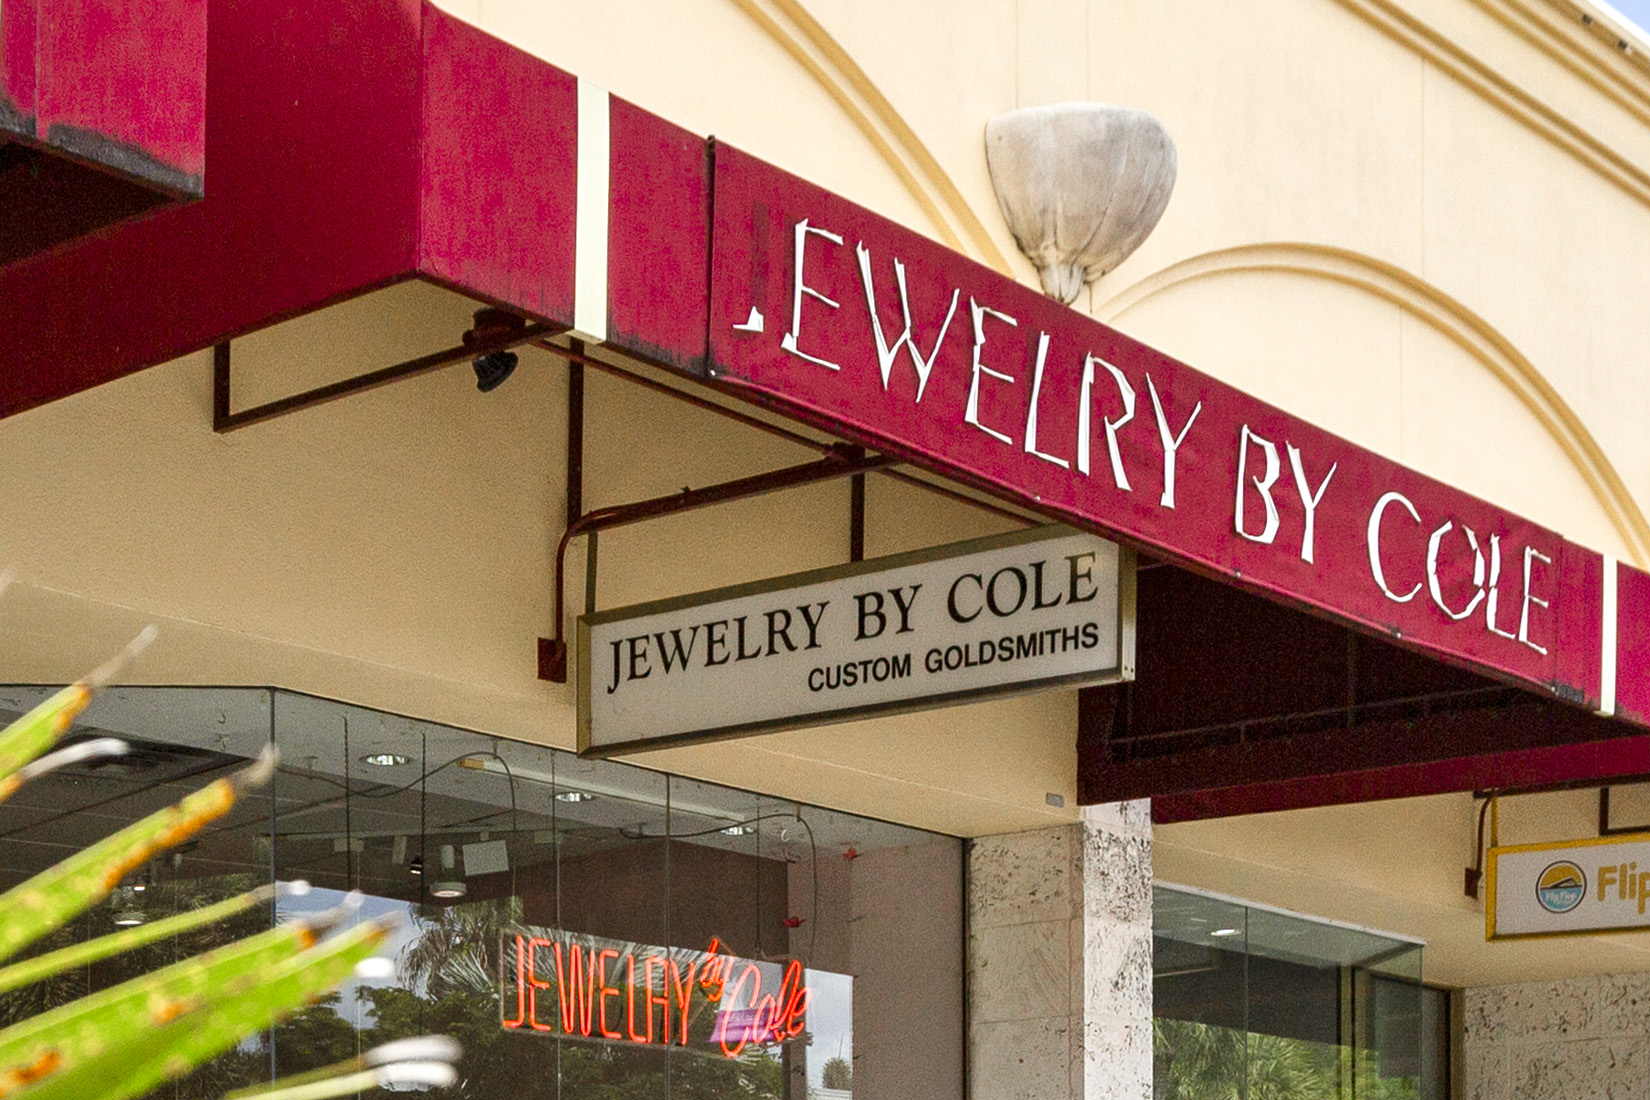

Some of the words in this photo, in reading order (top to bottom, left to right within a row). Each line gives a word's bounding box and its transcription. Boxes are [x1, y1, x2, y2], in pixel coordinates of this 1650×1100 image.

[733, 218, 1201, 510] EWELRY
[1234, 423, 1337, 564] BY
[1366, 491, 1553, 656] COLE
[607, 602, 829, 694] JEWELRY
[853, 584, 924, 641] BY
[947, 551, 1099, 624] COLE
[808, 654, 912, 692] CUSTOM
[925, 623, 1099, 675] GOLDSMITHS
[502, 934, 697, 1047] JEWELRY
[700, 937, 735, 1002] by
[719, 959, 813, 1058] Cole
